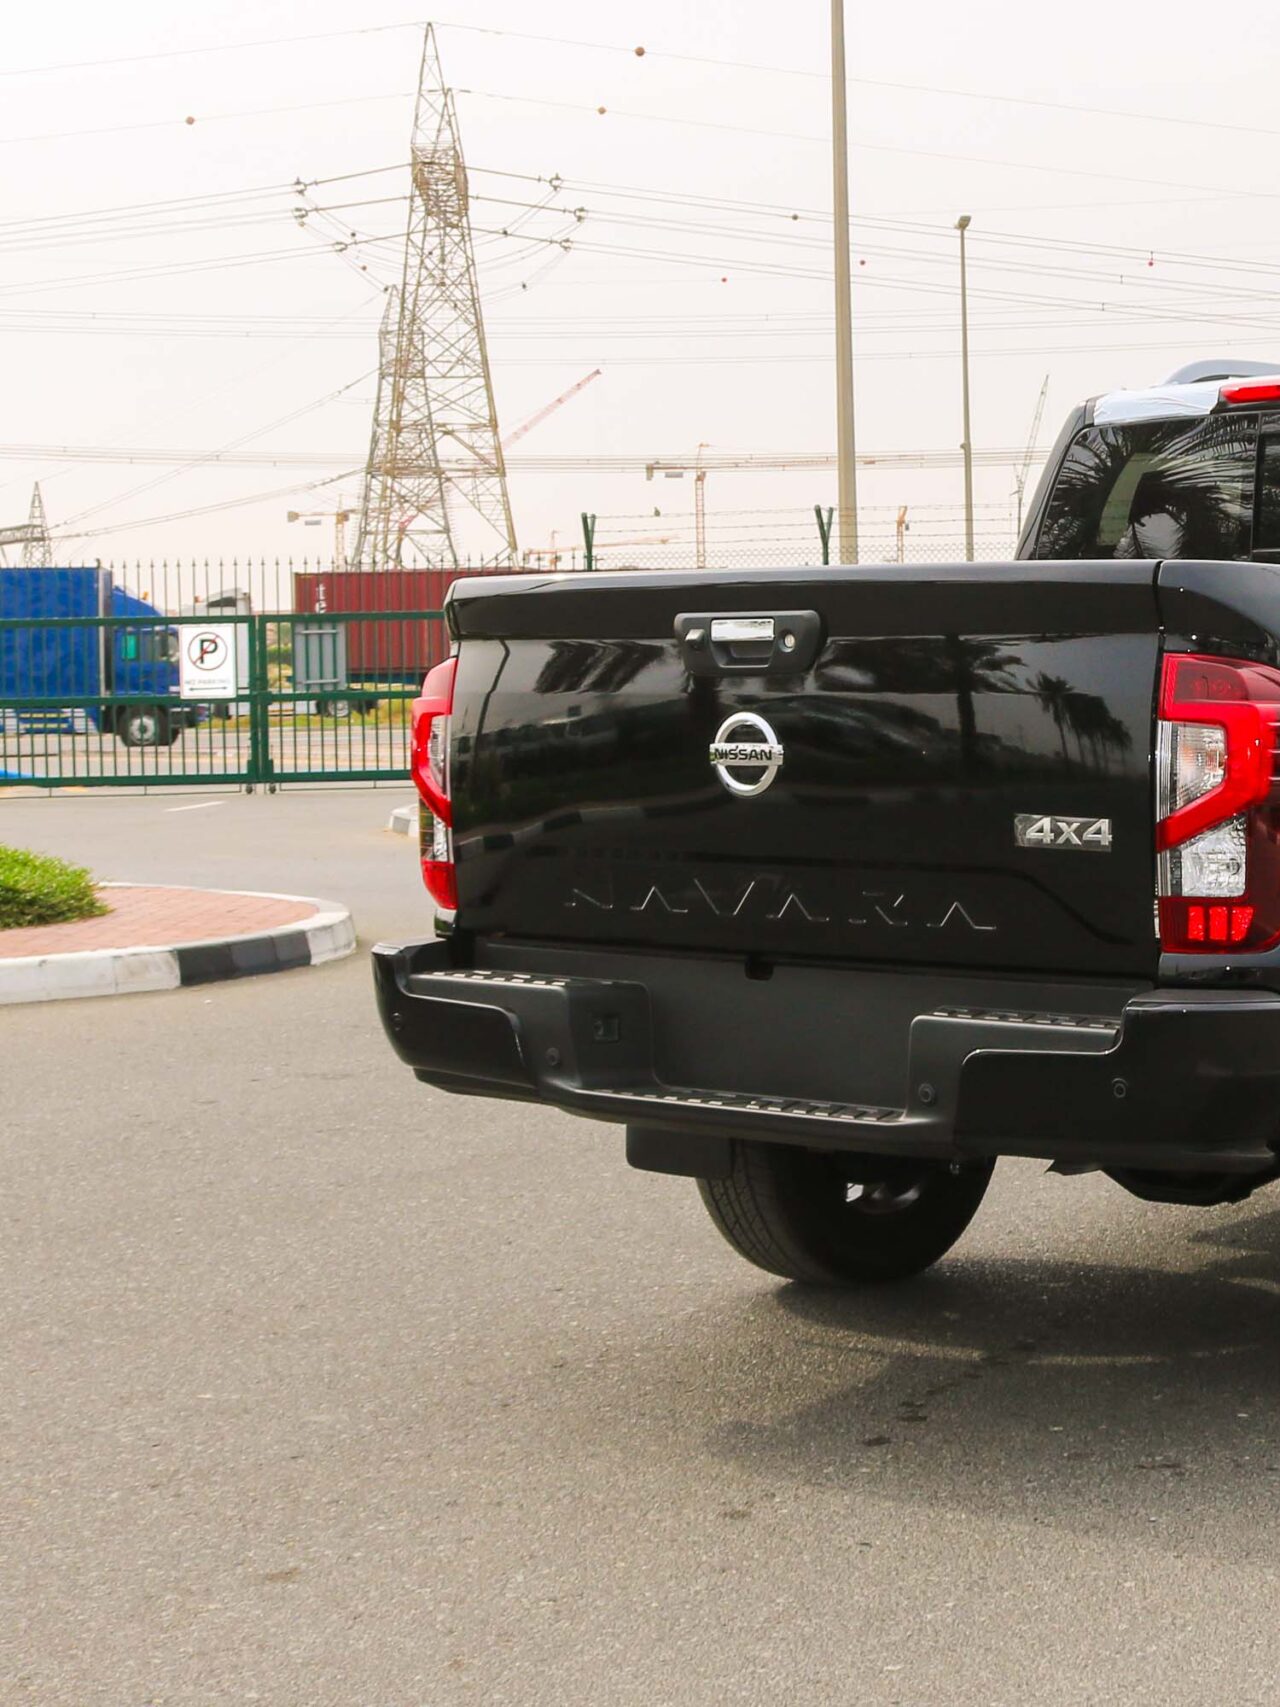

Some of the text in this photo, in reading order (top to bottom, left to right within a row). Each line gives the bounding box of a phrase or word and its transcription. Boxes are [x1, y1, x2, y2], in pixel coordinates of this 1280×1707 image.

[199, 638, 218, 664] P
[714, 748, 773, 761] NISSAN
[1025, 816, 1113, 846] 4x4
[564, 878, 997, 931] NAVARA
